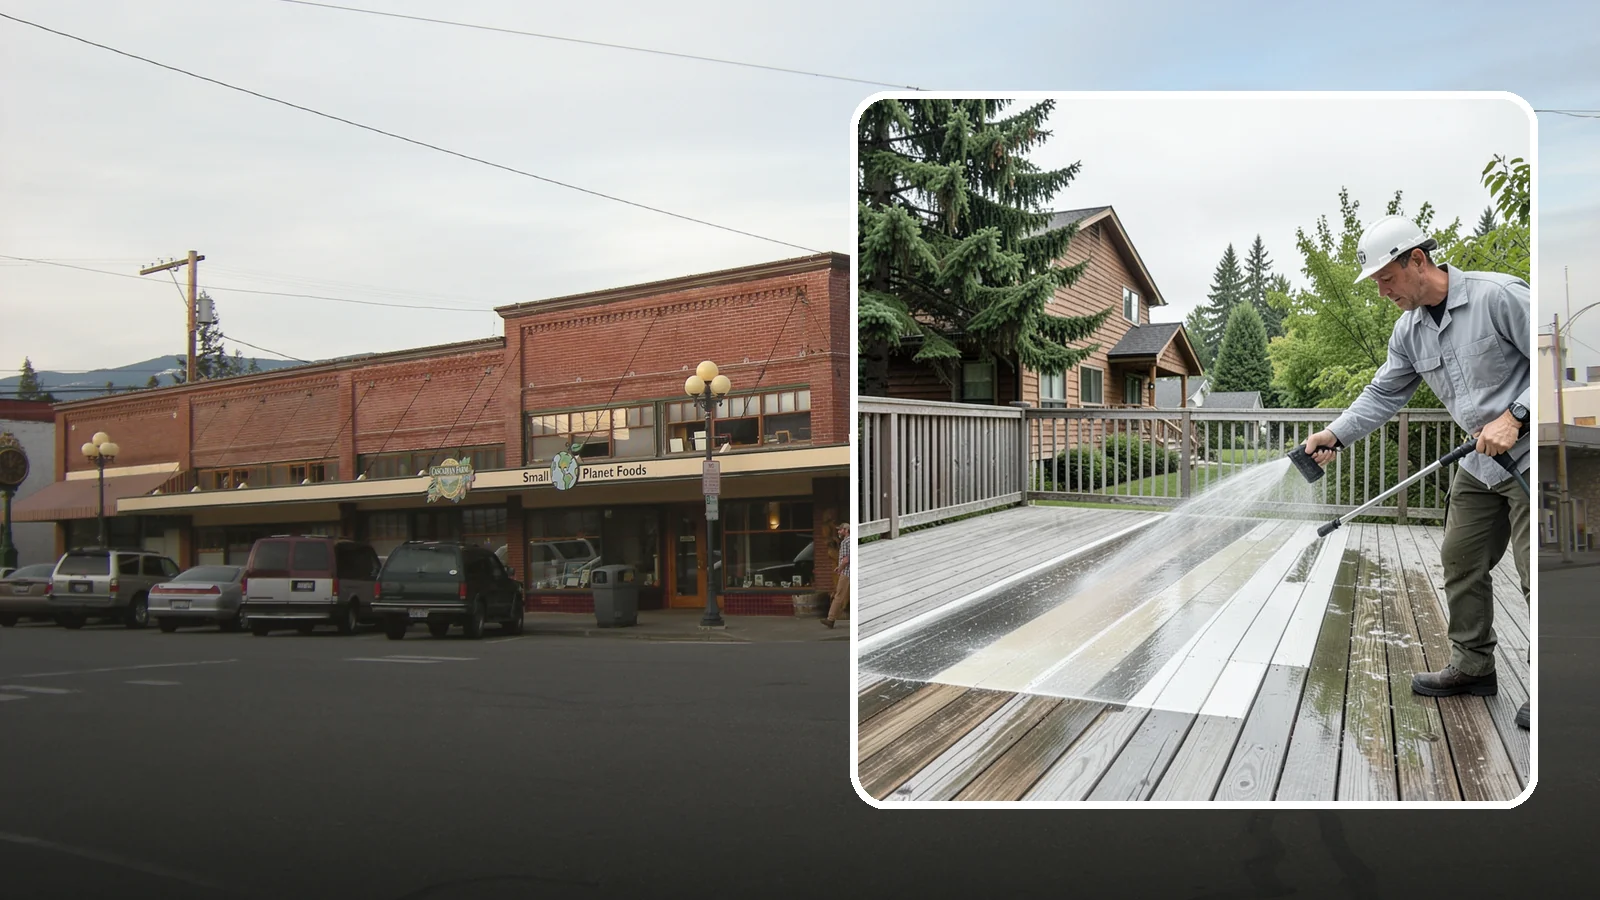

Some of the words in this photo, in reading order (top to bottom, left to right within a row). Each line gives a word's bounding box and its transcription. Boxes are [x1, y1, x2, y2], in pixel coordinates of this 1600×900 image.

[523, 471, 549, 483] Small
[583, 467, 614, 479] Planet
[617, 464, 647, 477] Foods
